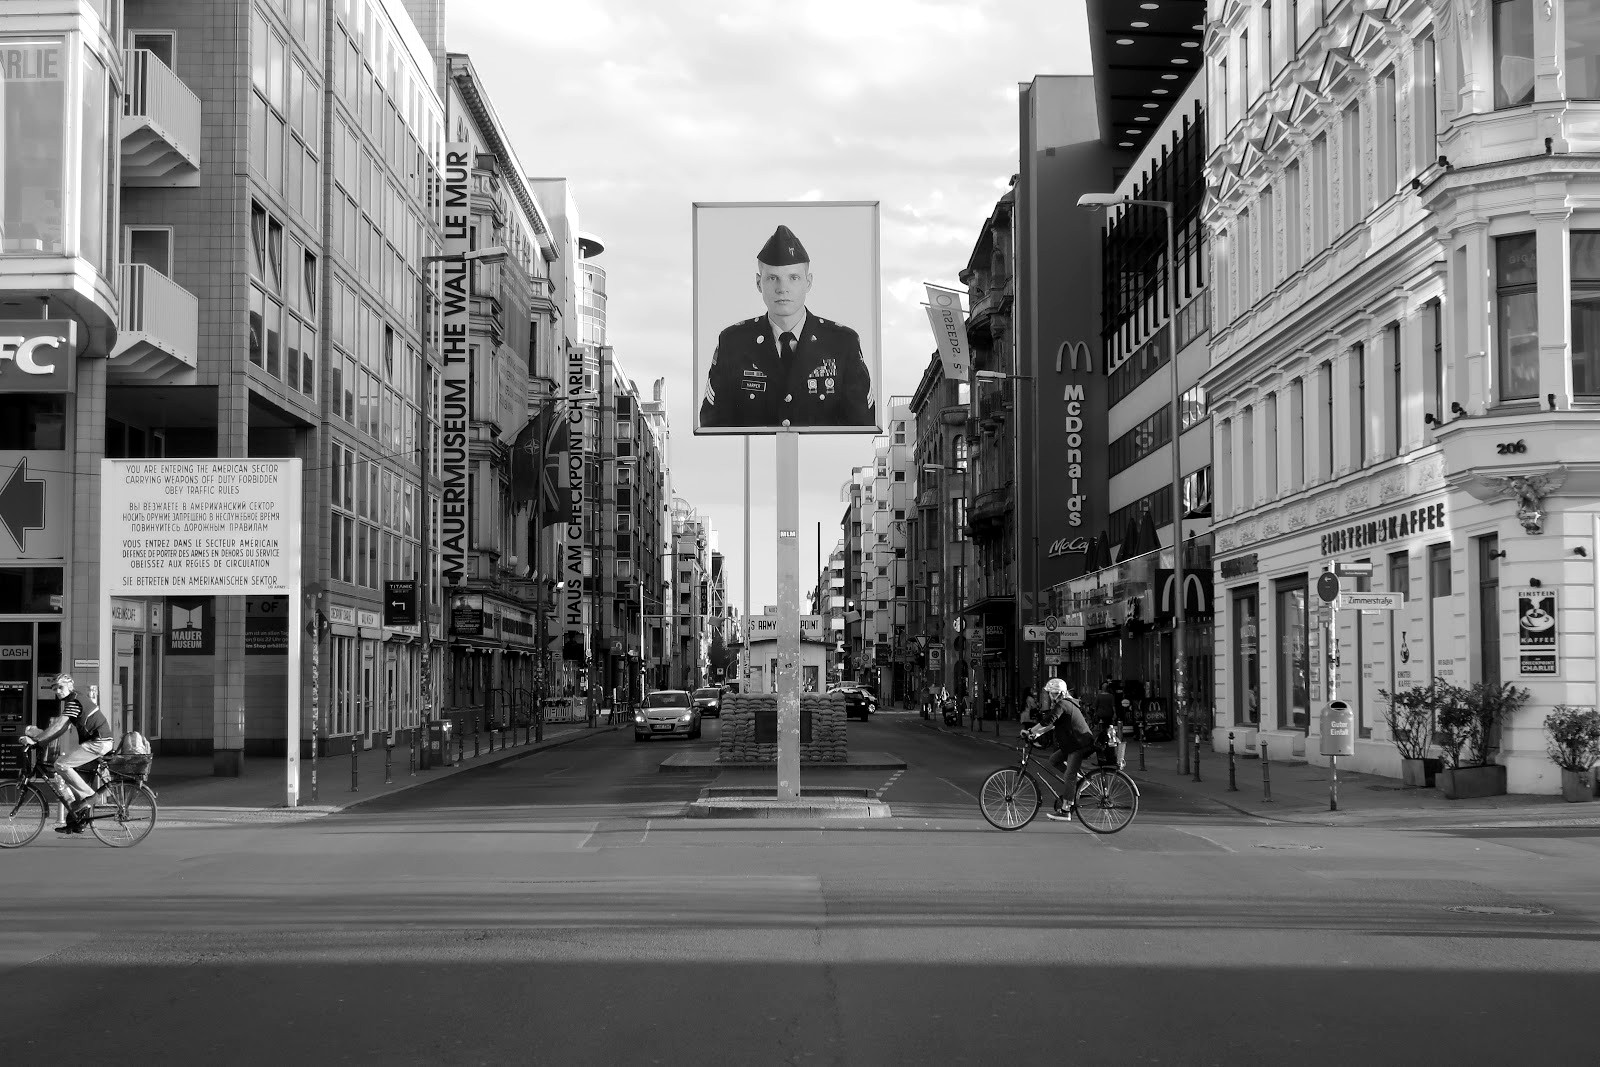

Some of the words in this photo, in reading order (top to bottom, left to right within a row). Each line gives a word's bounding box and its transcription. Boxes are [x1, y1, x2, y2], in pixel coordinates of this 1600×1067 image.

[0, 49, 58, 78] RLIE
[445, 151, 468, 207] MUR
[445, 215, 467, 239] LE
[444, 323, 466, 367] THE
[1497, 439, 1527, 454] 206
[1064, 384, 1087, 527] McDonald's
[126, 464, 141, 473] YOU
[143, 464, 157, 473] ARE
[160, 464, 194, 473] ENTERING
[196, 464, 209, 473] THE
[212, 464, 248, 473] AMERICAN
[251, 464, 279, 473] SECTOR
[125, 475, 162, 484] CARRYING
[164, 475, 199, 484] WEAPONS
[201, 475, 214, 484] OFF
[218, 475, 236, 484] DUTY
[238, 475, 278, 484] FORBIDDEN
[443, 379, 467, 575] MAUERMUSEUM
[165, 486, 184, 495] OBEY
[187, 486, 215, 494] TRAFFIC
[218, 486, 240, 494] RULES
[567, 431, 583, 540] CHECKPOINT
[129, 502, 140, 511] ВЫ
[182, 502, 187, 511] В
[190, 502, 246, 511] АМЕРИКАНСКИЙ
[249, 502, 275, 510] СЕКТОР
[122, 512, 145, 521] НОСИТЬ
[209, 512, 214, 521] В
[260, 512, 280, 521] ВРЕМЯ
[183, 523, 225, 532] ДОРОЖНЫМ
[229, 523, 268, 531] ПРАВИЛАМ
[1321, 521, 1377, 556] EINSTEIN
[1388, 502, 1445, 539] KAFFEE
[122, 539, 141, 548] VOUS
[145, 539, 170, 548] ENTREZ
[173, 539, 192, 548] DANS
[195, 539, 202, 548] LE
[205, 539, 236, 548] SECTEUR
[147, 549, 155, 558] DE
[156, 549, 177, 558] PORTER
[178, 549, 190, 558] DES
[190, 549, 210, 558] ARMES
[211, 549, 219, 558] EN
[221, 549, 244, 558] DEHORS
[245, 549, 254, 558] DU
[255, 549, 280, 557] SERVICE
[130, 559, 165, 568] OBEISSEZ
[168, 559, 182, 568] AUX
[185, 559, 210, 568] REGLES
[213, 559, 222, 568] DE
[225, 559, 270, 568] CIRCULATION
[568, 546, 582, 574] AM
[122, 576, 133, 586] SIE
[136, 576, 169, 586] BETRETEN
[172, 576, 186, 586] DEN
[188, 576, 248, 586] AMERIKANISCHEN
[251, 576, 278, 586] SEKTOR
[567, 579, 582, 625] HAUS
[1348, 595, 1393, 606] Zimmerstraße
[261, 601, 279, 613] OF
[758, 620, 777, 630] ARMY
[800, 619, 819, 630] POINT
[171, 631, 203, 641] MAUER
[171, 640, 203, 649] MUSEUM
[2, 649, 29, 657] CASH
